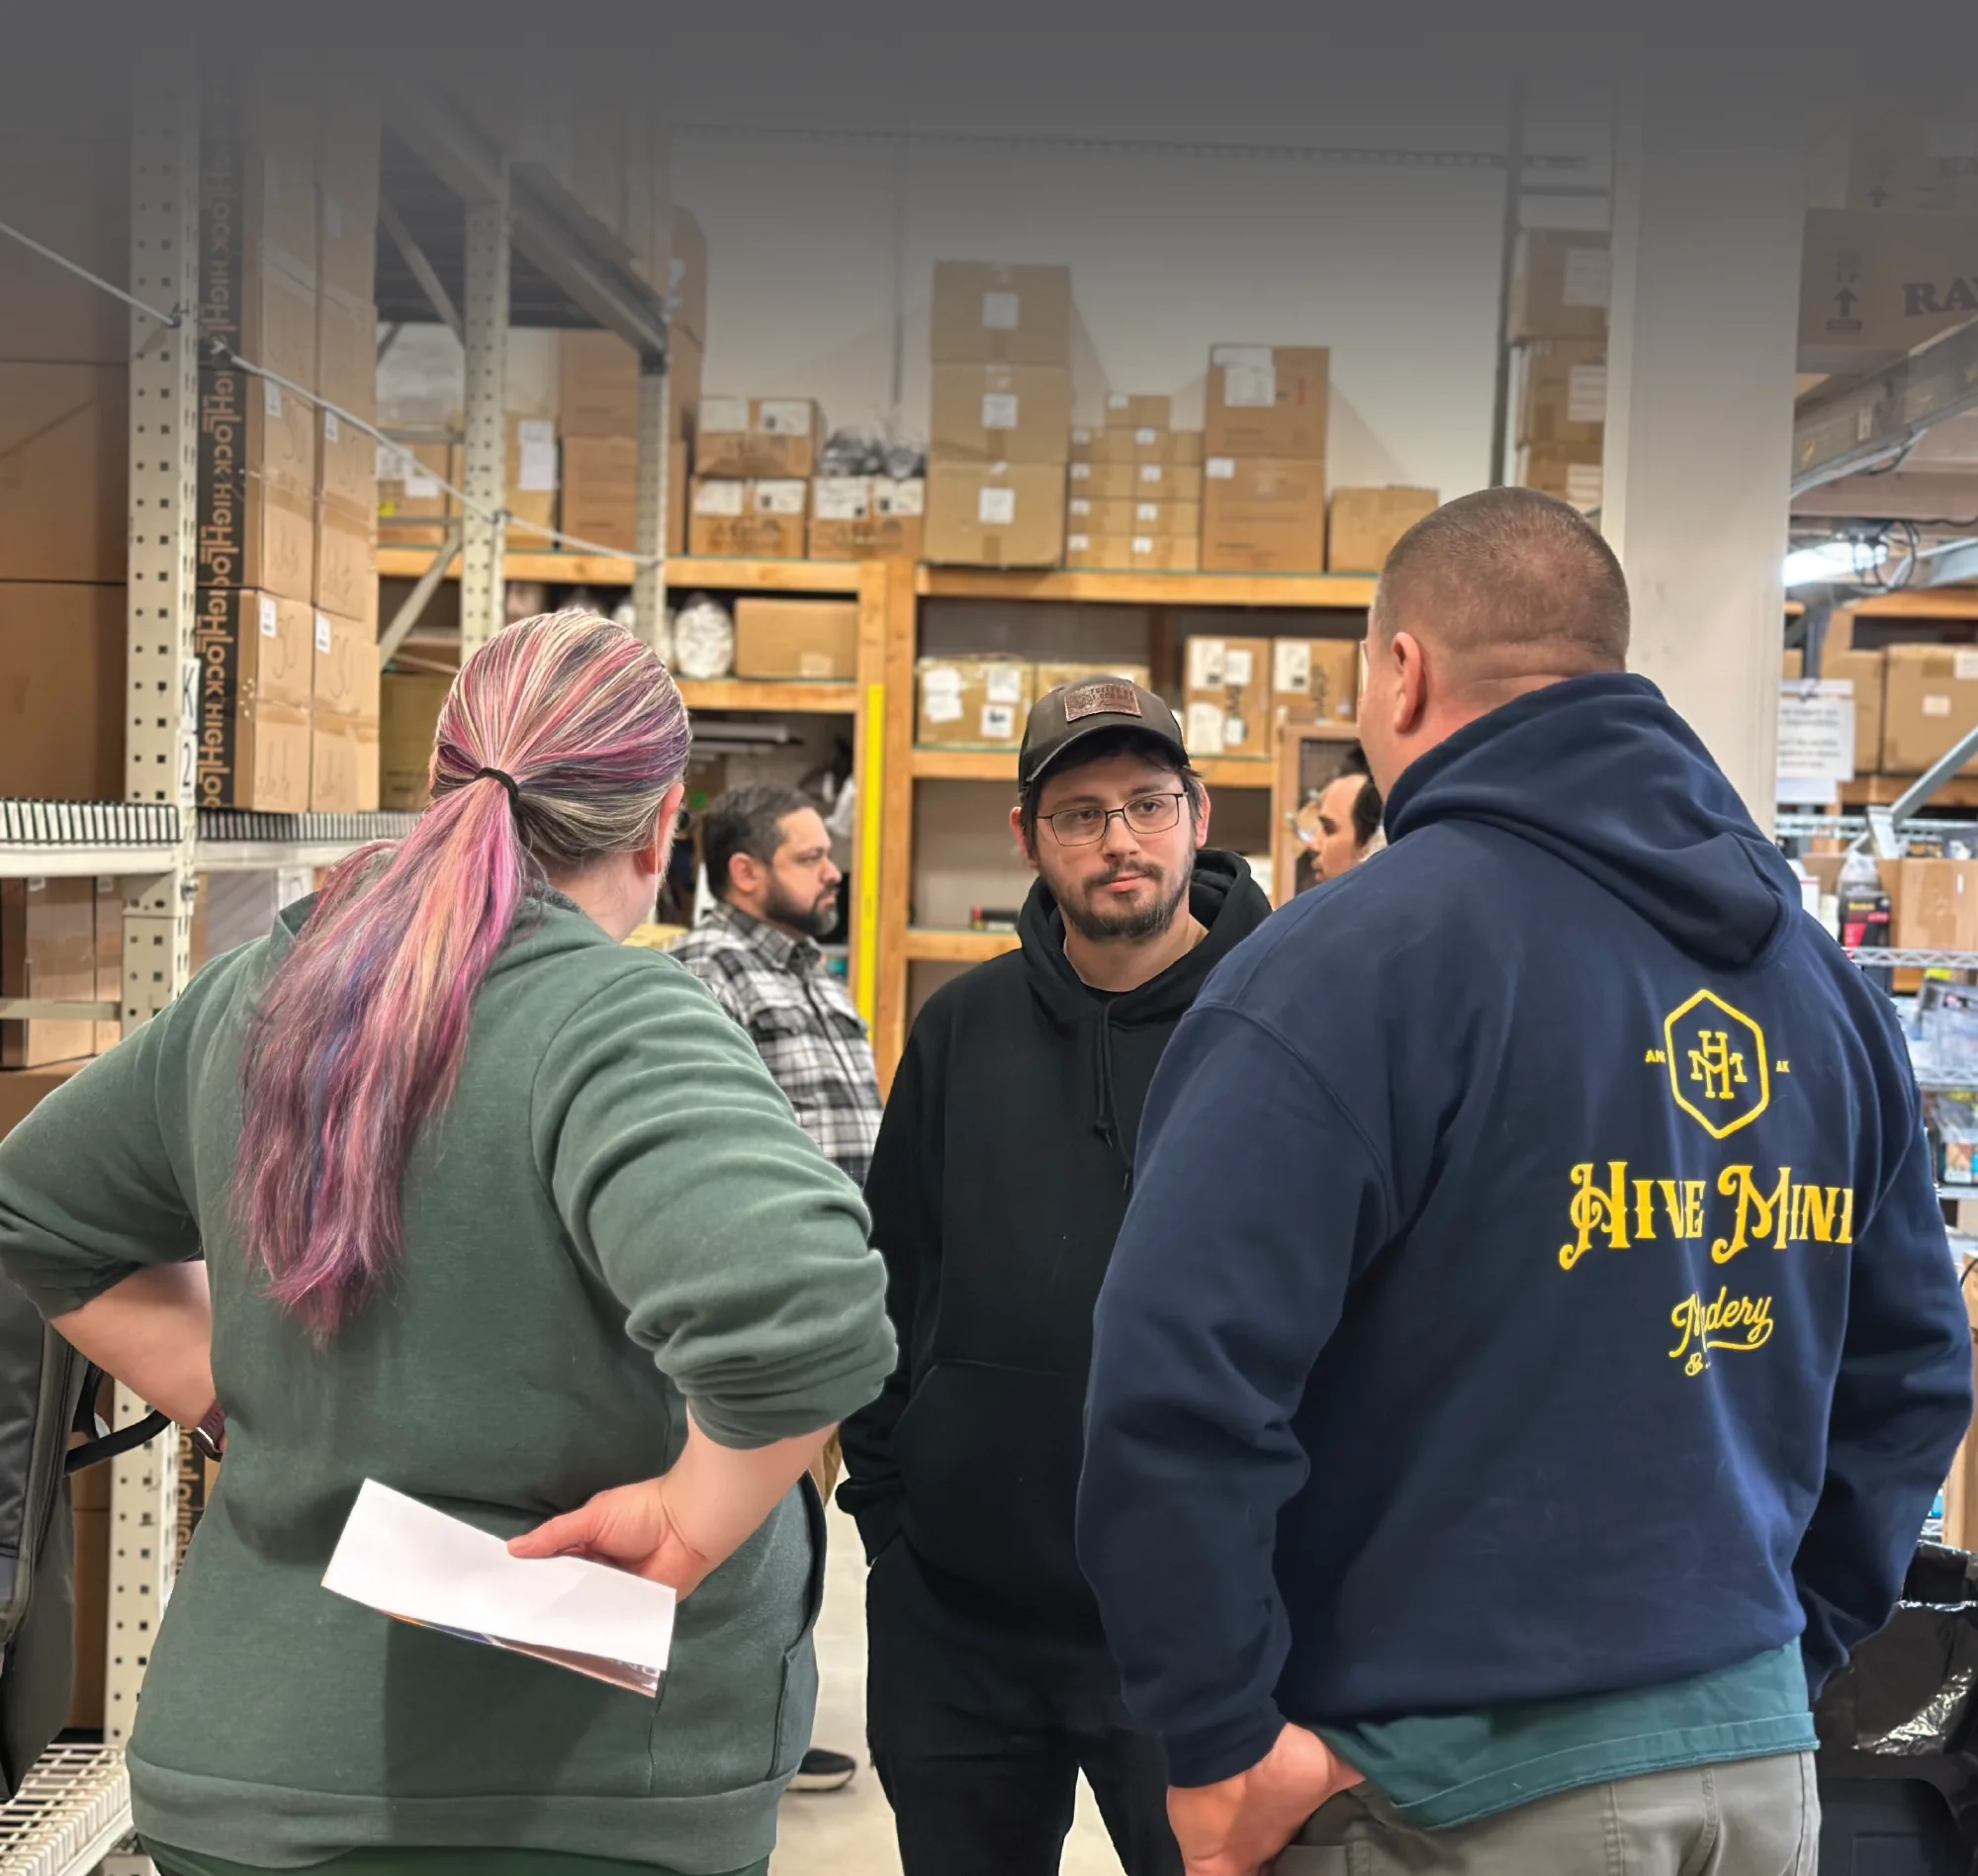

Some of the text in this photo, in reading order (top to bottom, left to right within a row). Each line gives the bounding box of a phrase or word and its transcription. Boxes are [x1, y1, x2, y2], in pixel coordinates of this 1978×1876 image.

[1903, 277, 1978, 317] RA
[181, 664, 196, 718] K
[181, 742, 192, 788] 2
[1560, 1161, 1707, 1270] HIVE
